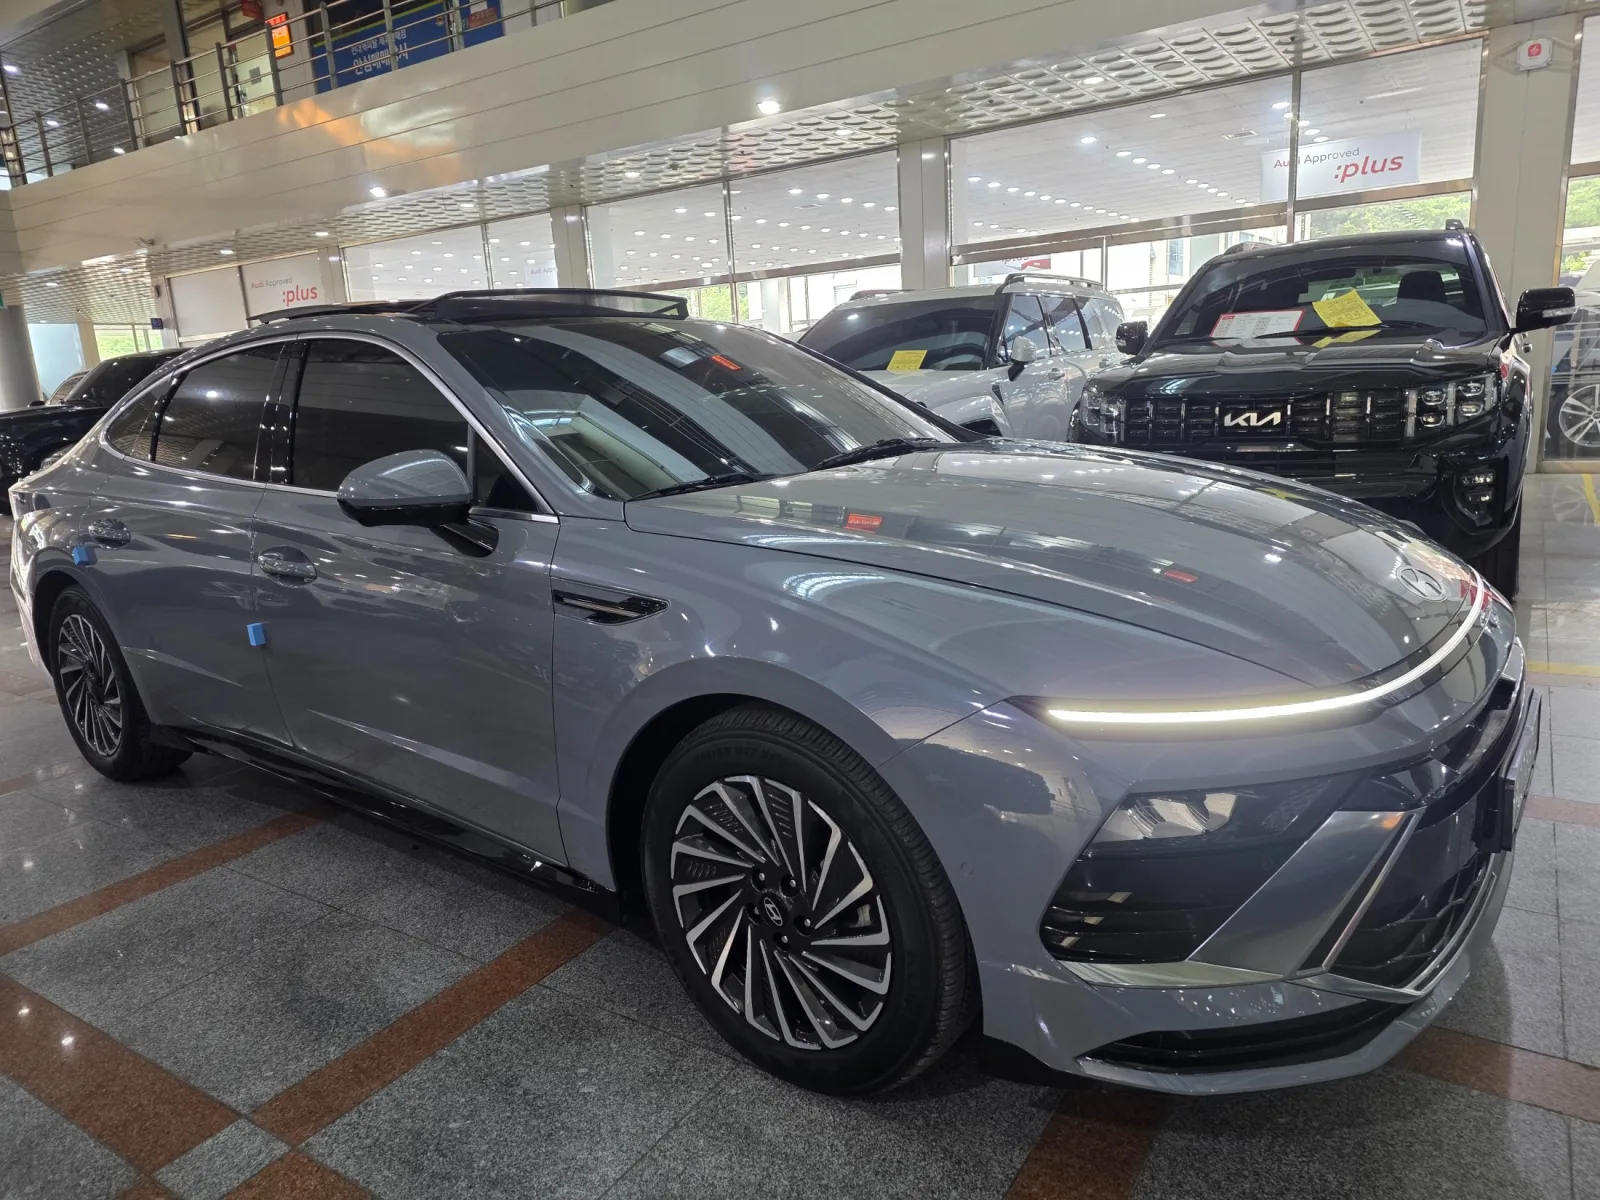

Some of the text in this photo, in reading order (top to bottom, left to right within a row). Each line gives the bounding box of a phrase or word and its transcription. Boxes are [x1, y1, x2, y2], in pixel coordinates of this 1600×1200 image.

[1273, 147, 1360, 168] Aui Approved
[1334, 155, 1404, 183] :plus
[250, 276, 293, 289] Audi Approved
[282, 284, 318, 307] :plus
